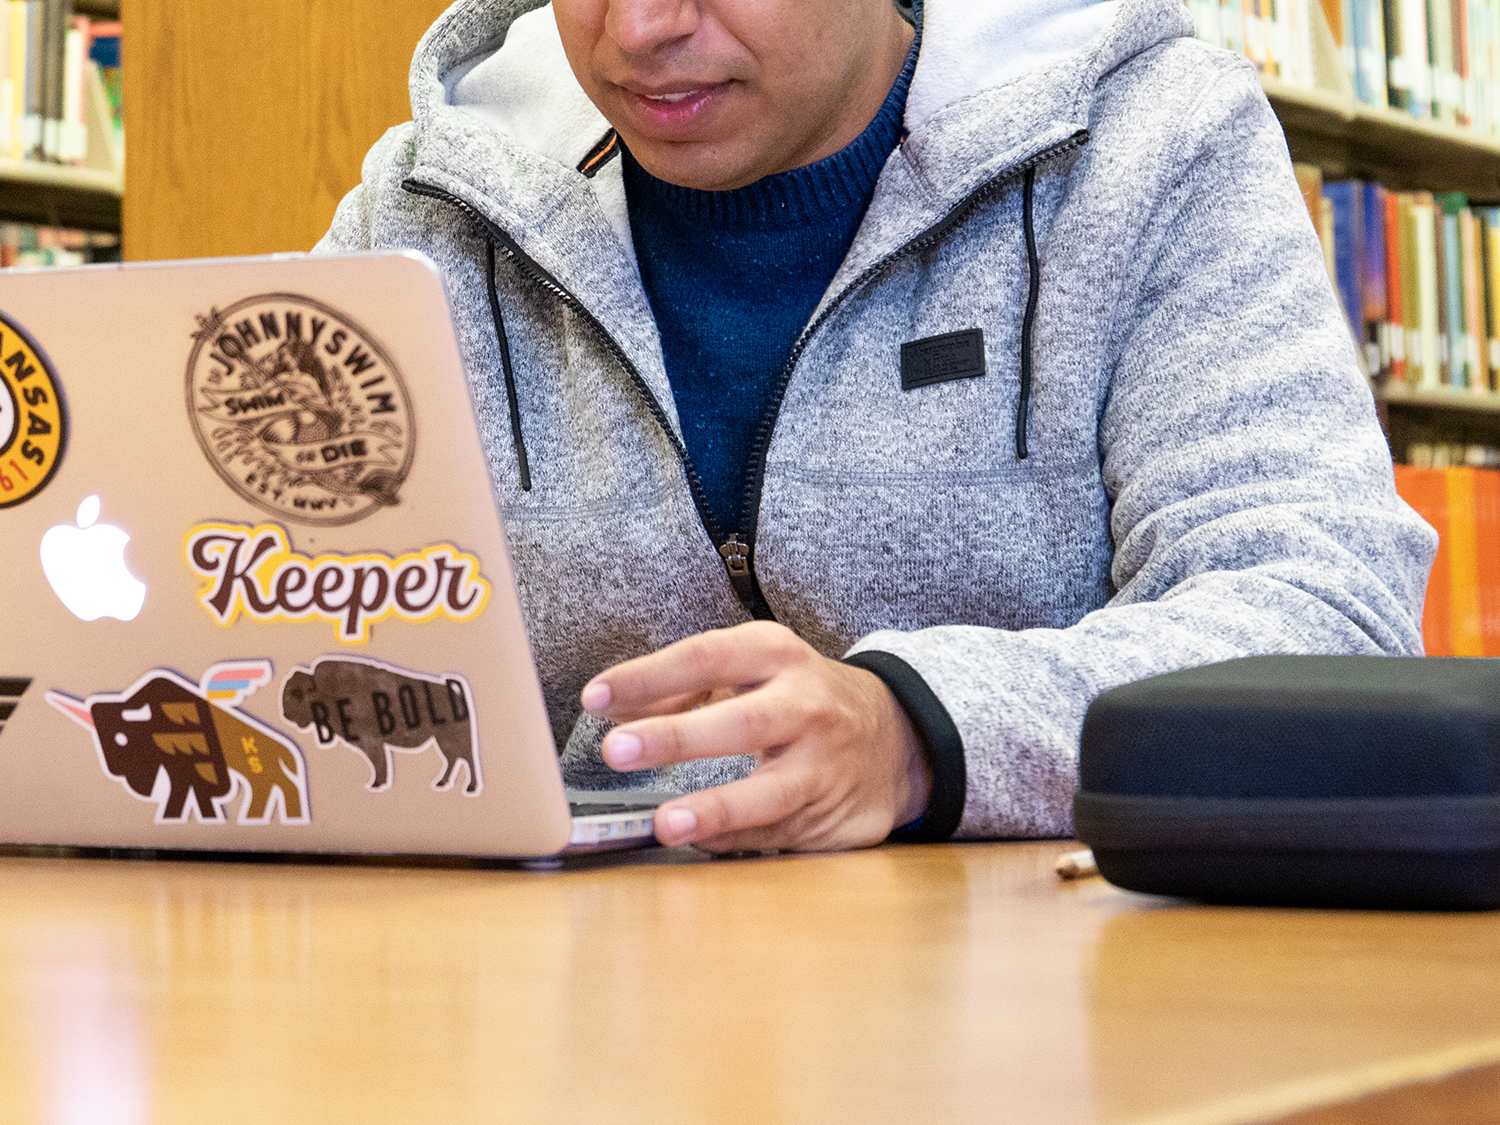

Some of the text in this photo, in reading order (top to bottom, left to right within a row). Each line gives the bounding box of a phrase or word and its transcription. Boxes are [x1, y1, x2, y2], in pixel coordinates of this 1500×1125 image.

[210, 311, 396, 414] JOHNNYSWIM
[191, 534, 480, 635] Keeper
[310, 678, 469, 744] BE BOLD
[241, 736, 263, 774] KS
